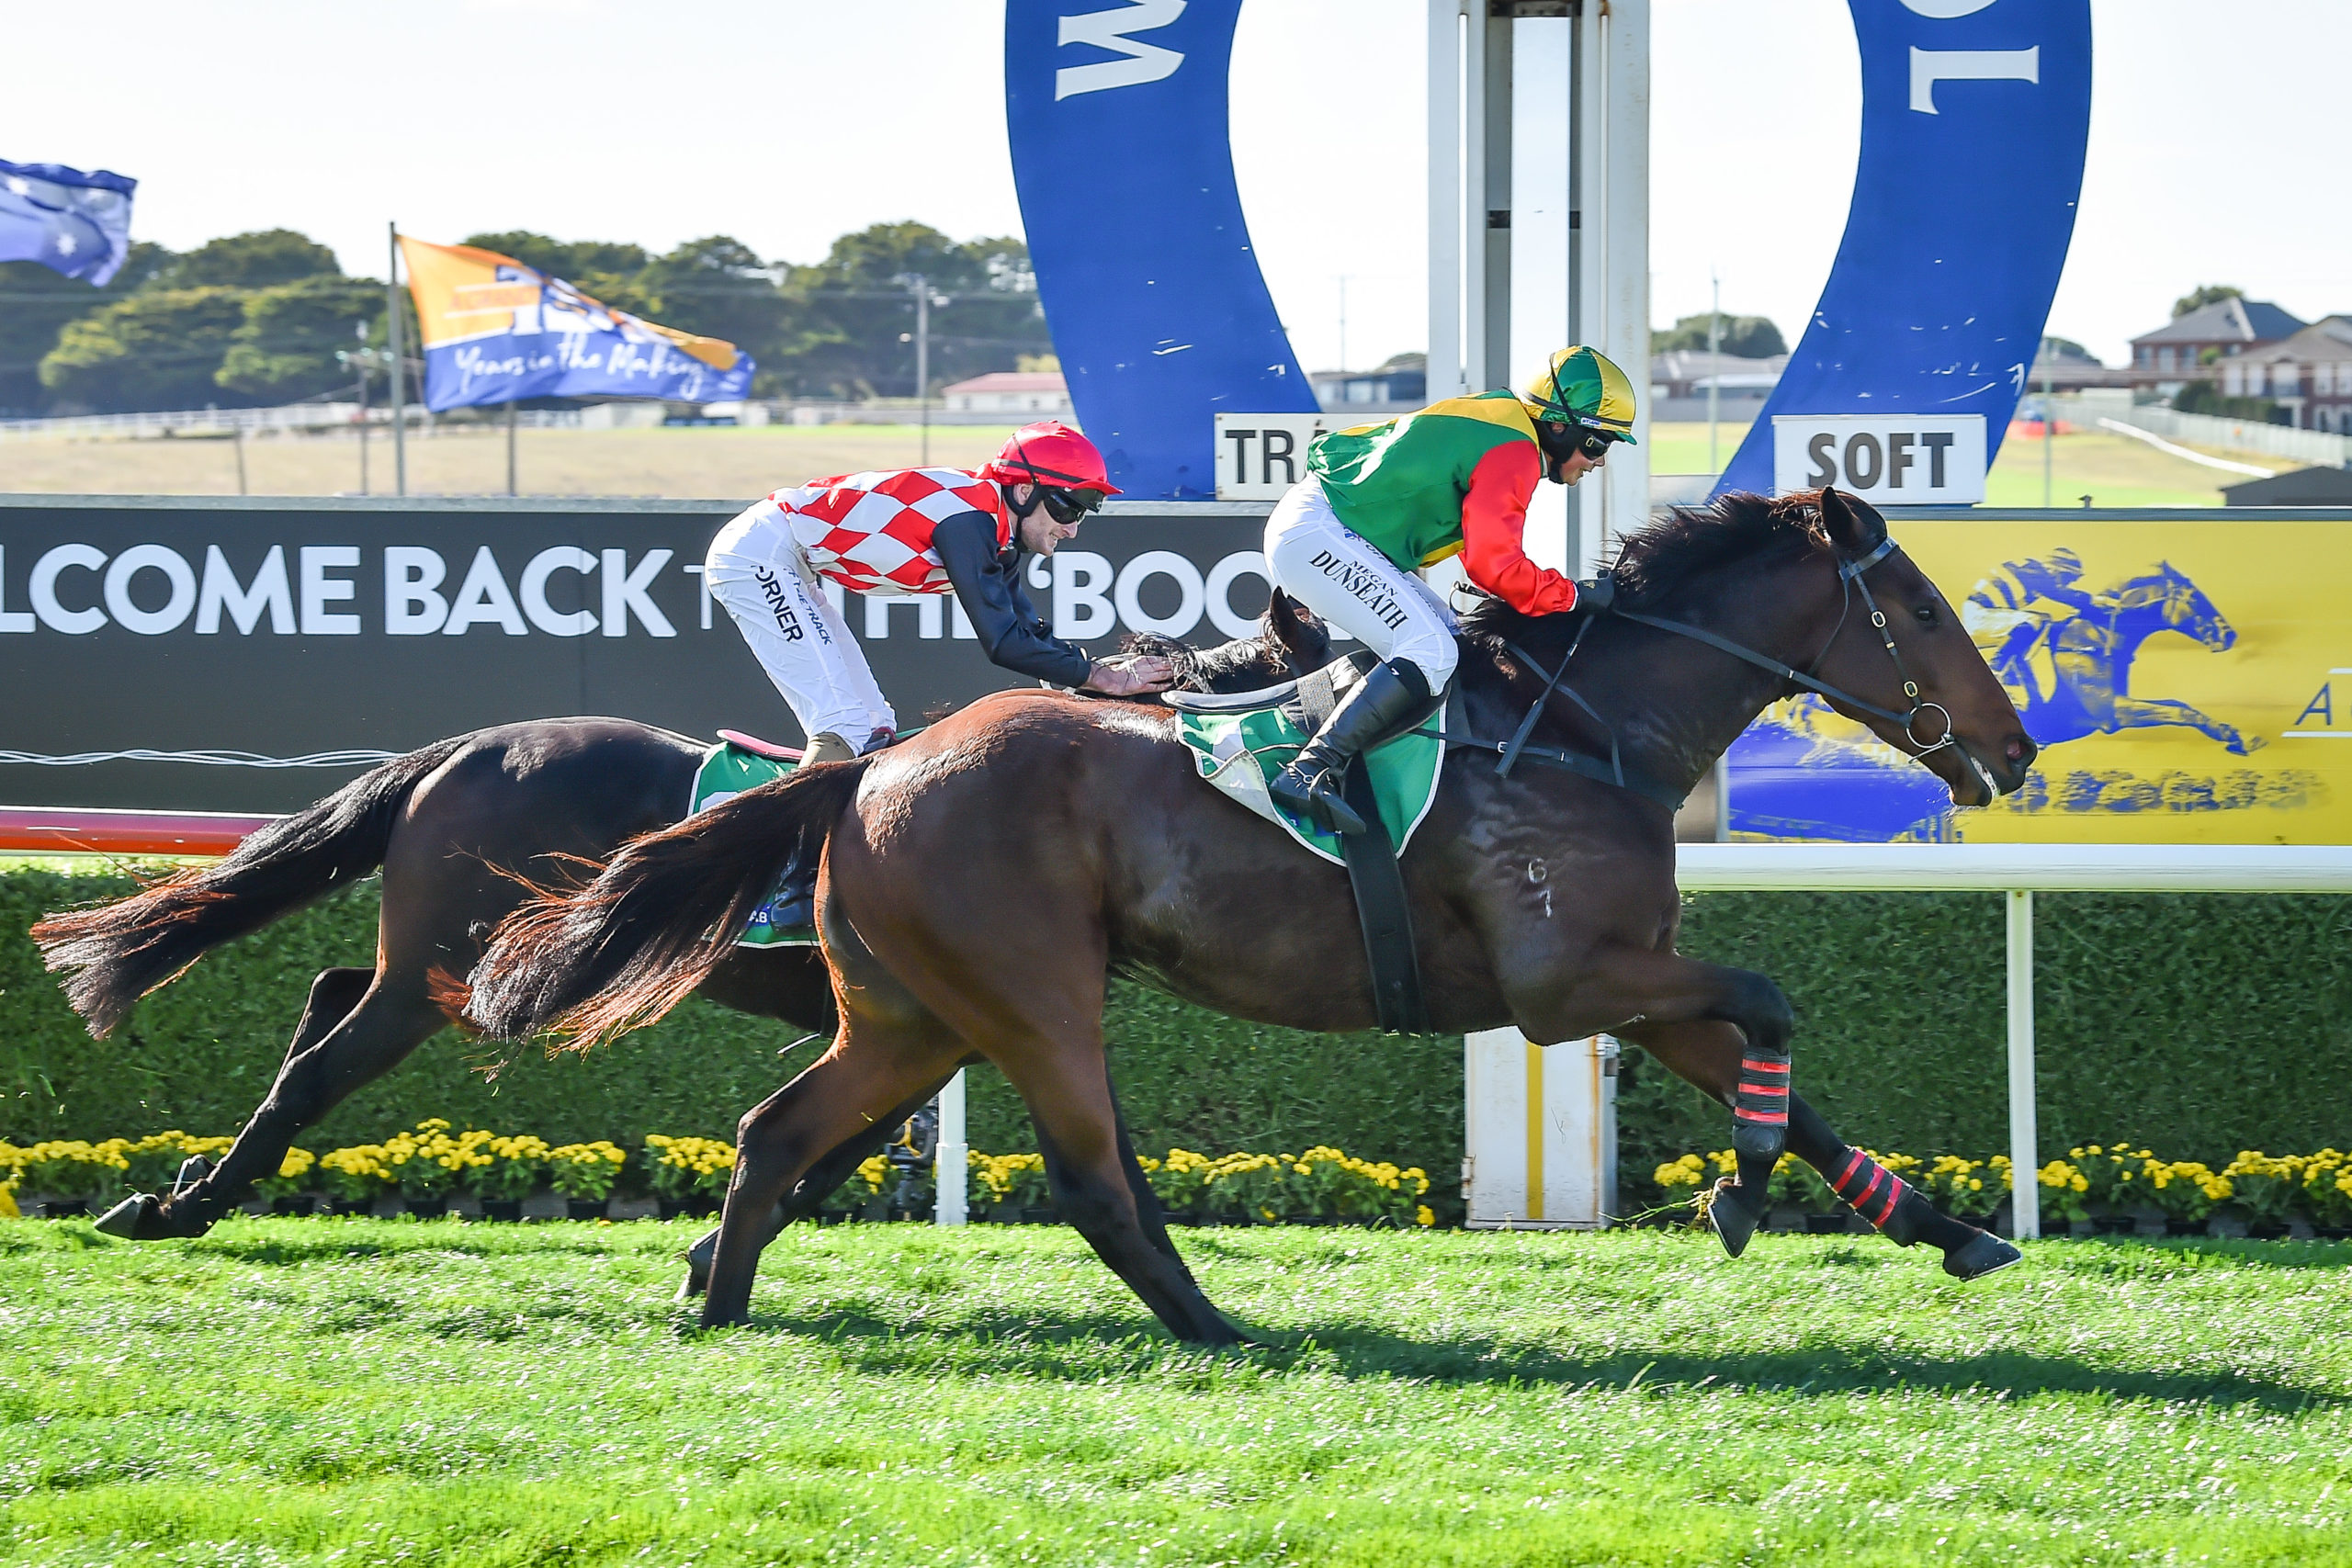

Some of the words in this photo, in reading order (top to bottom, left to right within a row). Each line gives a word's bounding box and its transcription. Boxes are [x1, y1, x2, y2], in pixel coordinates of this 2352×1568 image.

[455, 345, 526, 395] Years
[526, 350, 553, 371] in
[1225, 429, 1327, 484] TR
[1808, 432, 1954, 490] SOFT
[385, 546, 678, 637] BACK
[750, 565, 804, 642] ORNER
[1308, 549, 1409, 632] DUNSEATH
[1350, 560, 1398, 597] MEGAN
[805, 606, 832, 645] TRACK
